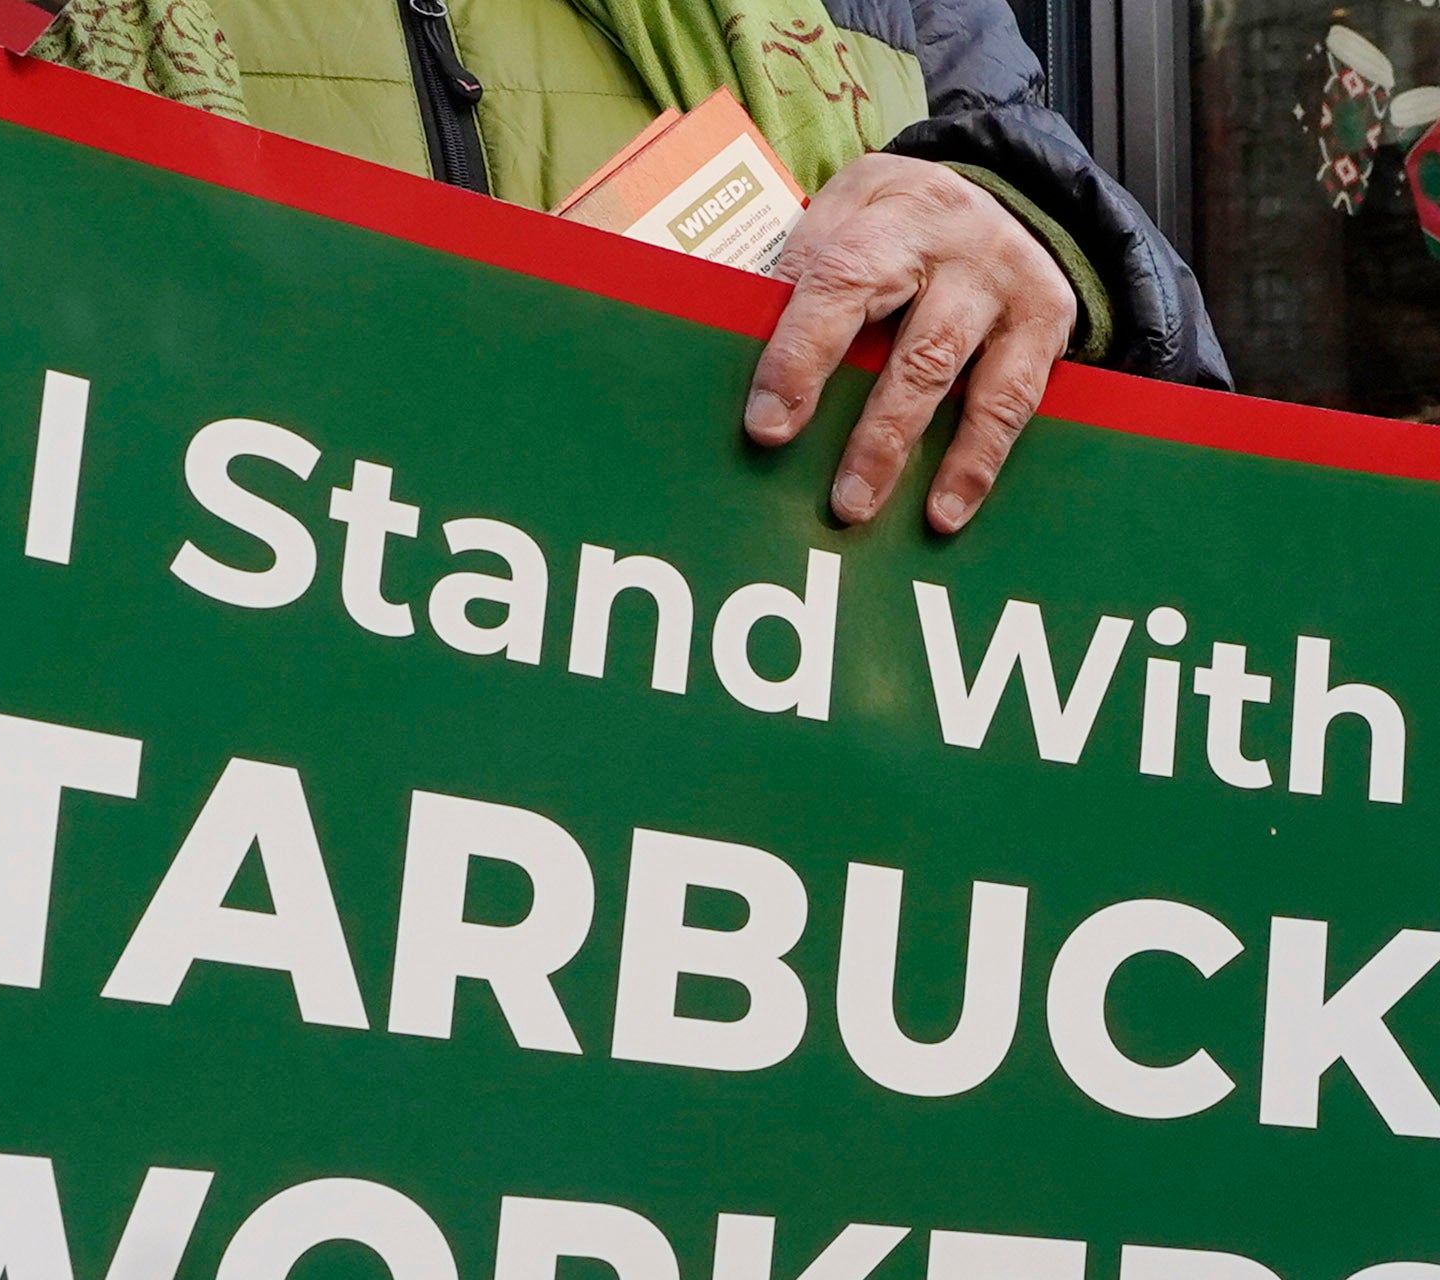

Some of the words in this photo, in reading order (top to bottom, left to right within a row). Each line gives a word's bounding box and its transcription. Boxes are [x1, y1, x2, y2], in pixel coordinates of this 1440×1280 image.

[676, 174, 754, 241] WIRED:
[23, 368, 92, 566] I
[168, 417, 843, 723] Stand
[911, 579, 1407, 805] With
